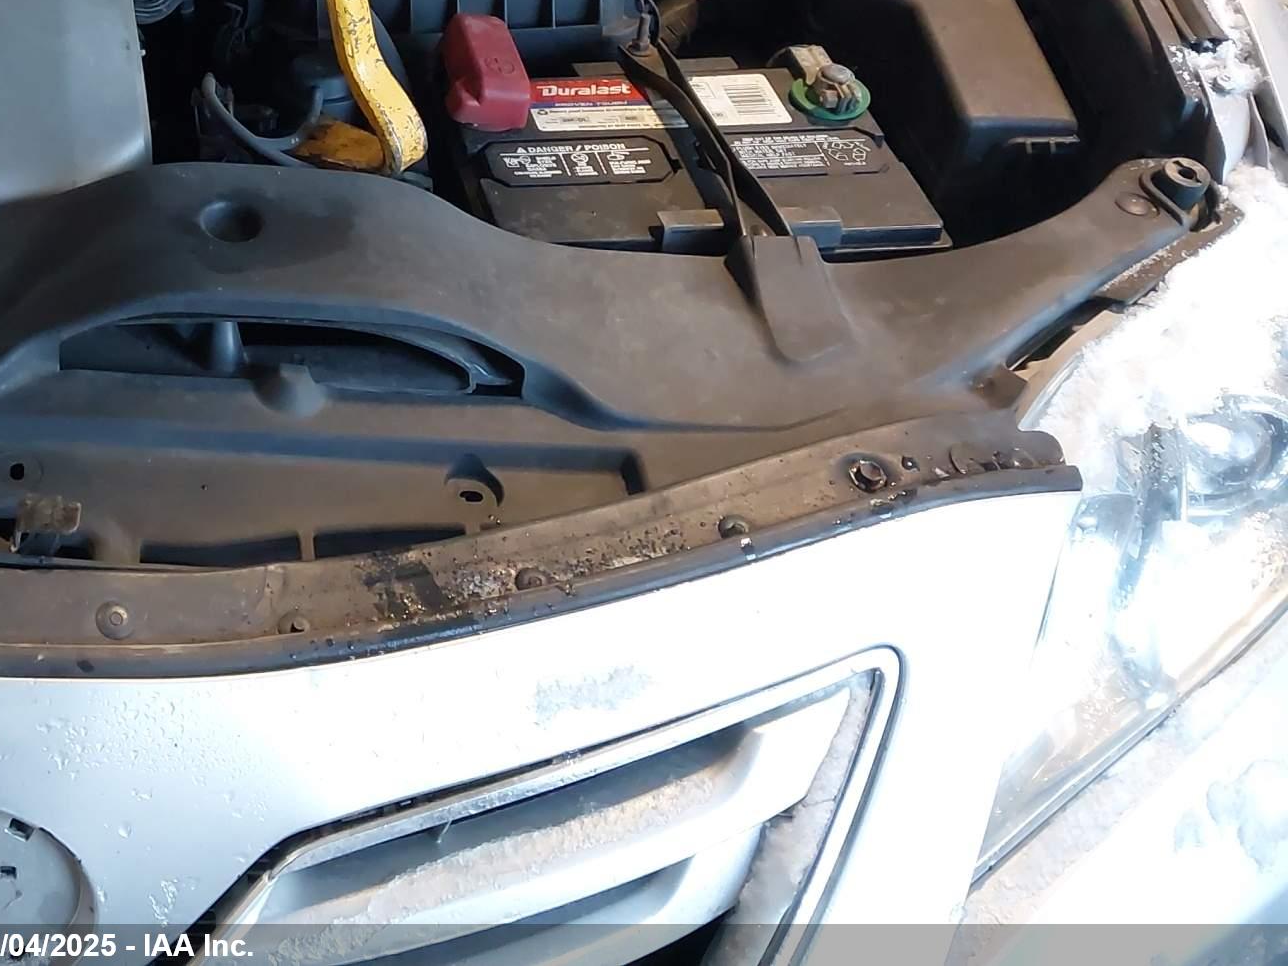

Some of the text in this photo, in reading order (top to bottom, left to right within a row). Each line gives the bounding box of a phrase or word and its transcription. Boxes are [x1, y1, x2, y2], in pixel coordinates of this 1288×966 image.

[536, 82, 632, 97] Duralast
[527, 144, 574, 154] DANGER
[584, 143, 626, 152] POISON
